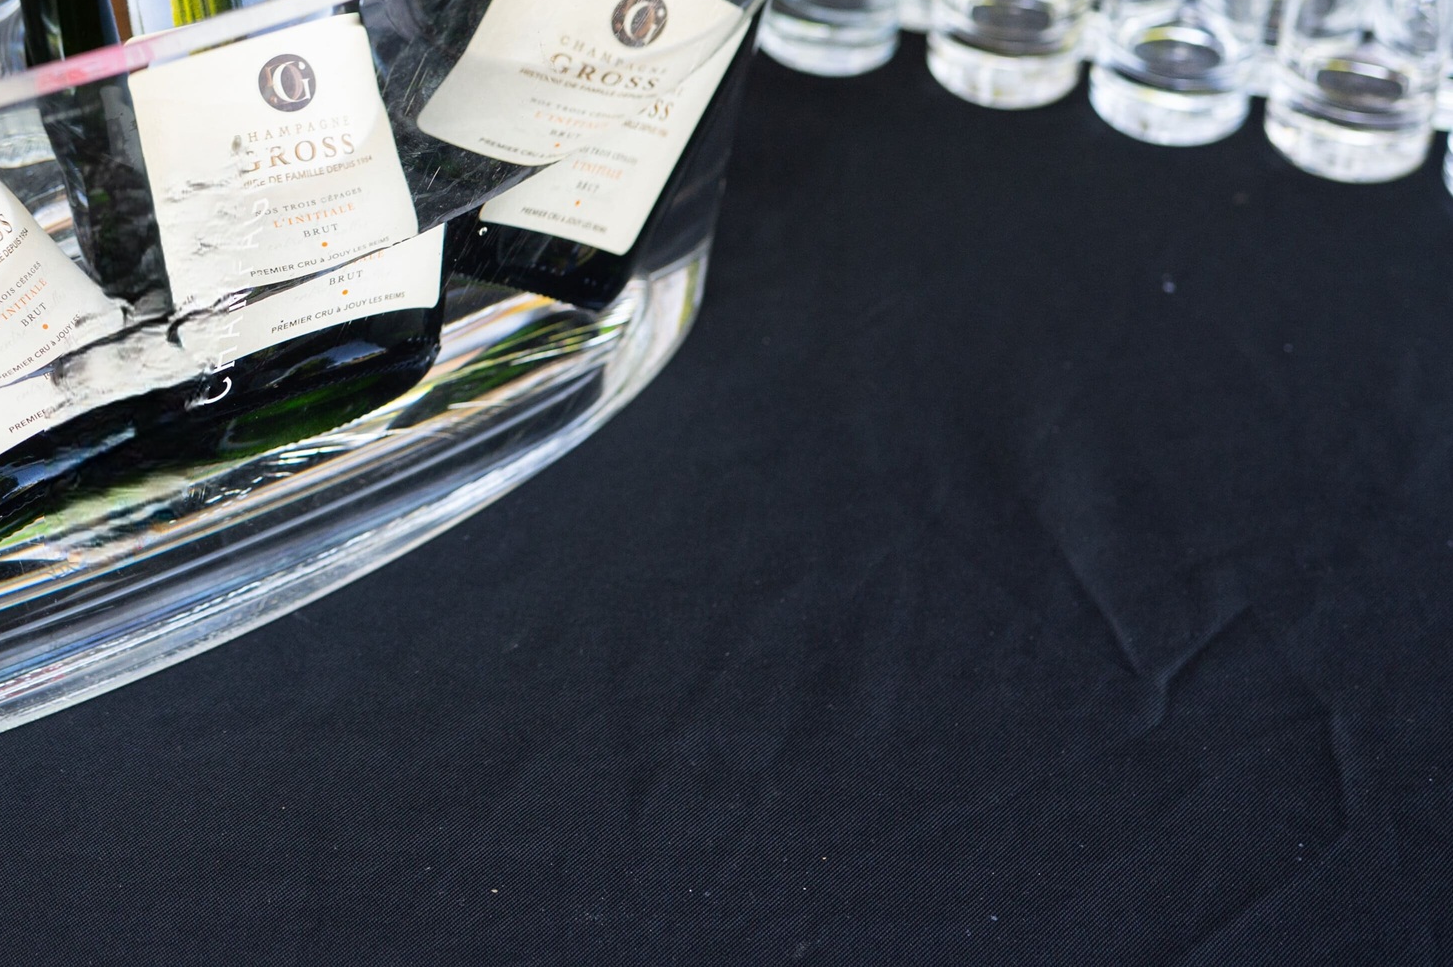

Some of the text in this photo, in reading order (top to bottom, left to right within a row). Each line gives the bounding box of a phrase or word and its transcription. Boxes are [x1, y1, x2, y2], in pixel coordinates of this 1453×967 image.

[550, 52, 659, 90] GROSS
[269, 174, 282, 184] DE
[285, 167, 325, 182] FAMILLE
[326, 159, 356, 174] DEPUIS
[283, 199, 317, 211] TROIS
[320, 187, 362, 204] CÉPAGES
[274, 202, 355, 228] L'INITIALE
[303, 223, 339, 238] BRUT
[4, 237, 22, 258] DEPUIS
[250, 264, 294, 277] PREMIER
[297, 258, 317, 269] CRU
[327, 249, 351, 261] JOUY
[353, 243, 367, 253] LES
[368, 236, 390, 248] REIMS
[15, 261, 42, 289] CÉPAGES
[329, 269, 363, 286] BRUT
[21, 302, 47, 327] BRUT
[271, 314, 312, 334] PREMIER
[314, 308, 334, 319] CRU
[343, 299, 367, 311] JOUY
[368, 295, 383, 305] LES
[384, 290, 406, 301] REIMS
[34, 344, 51, 359] CRU
[55, 322, 73, 343] JOUY
